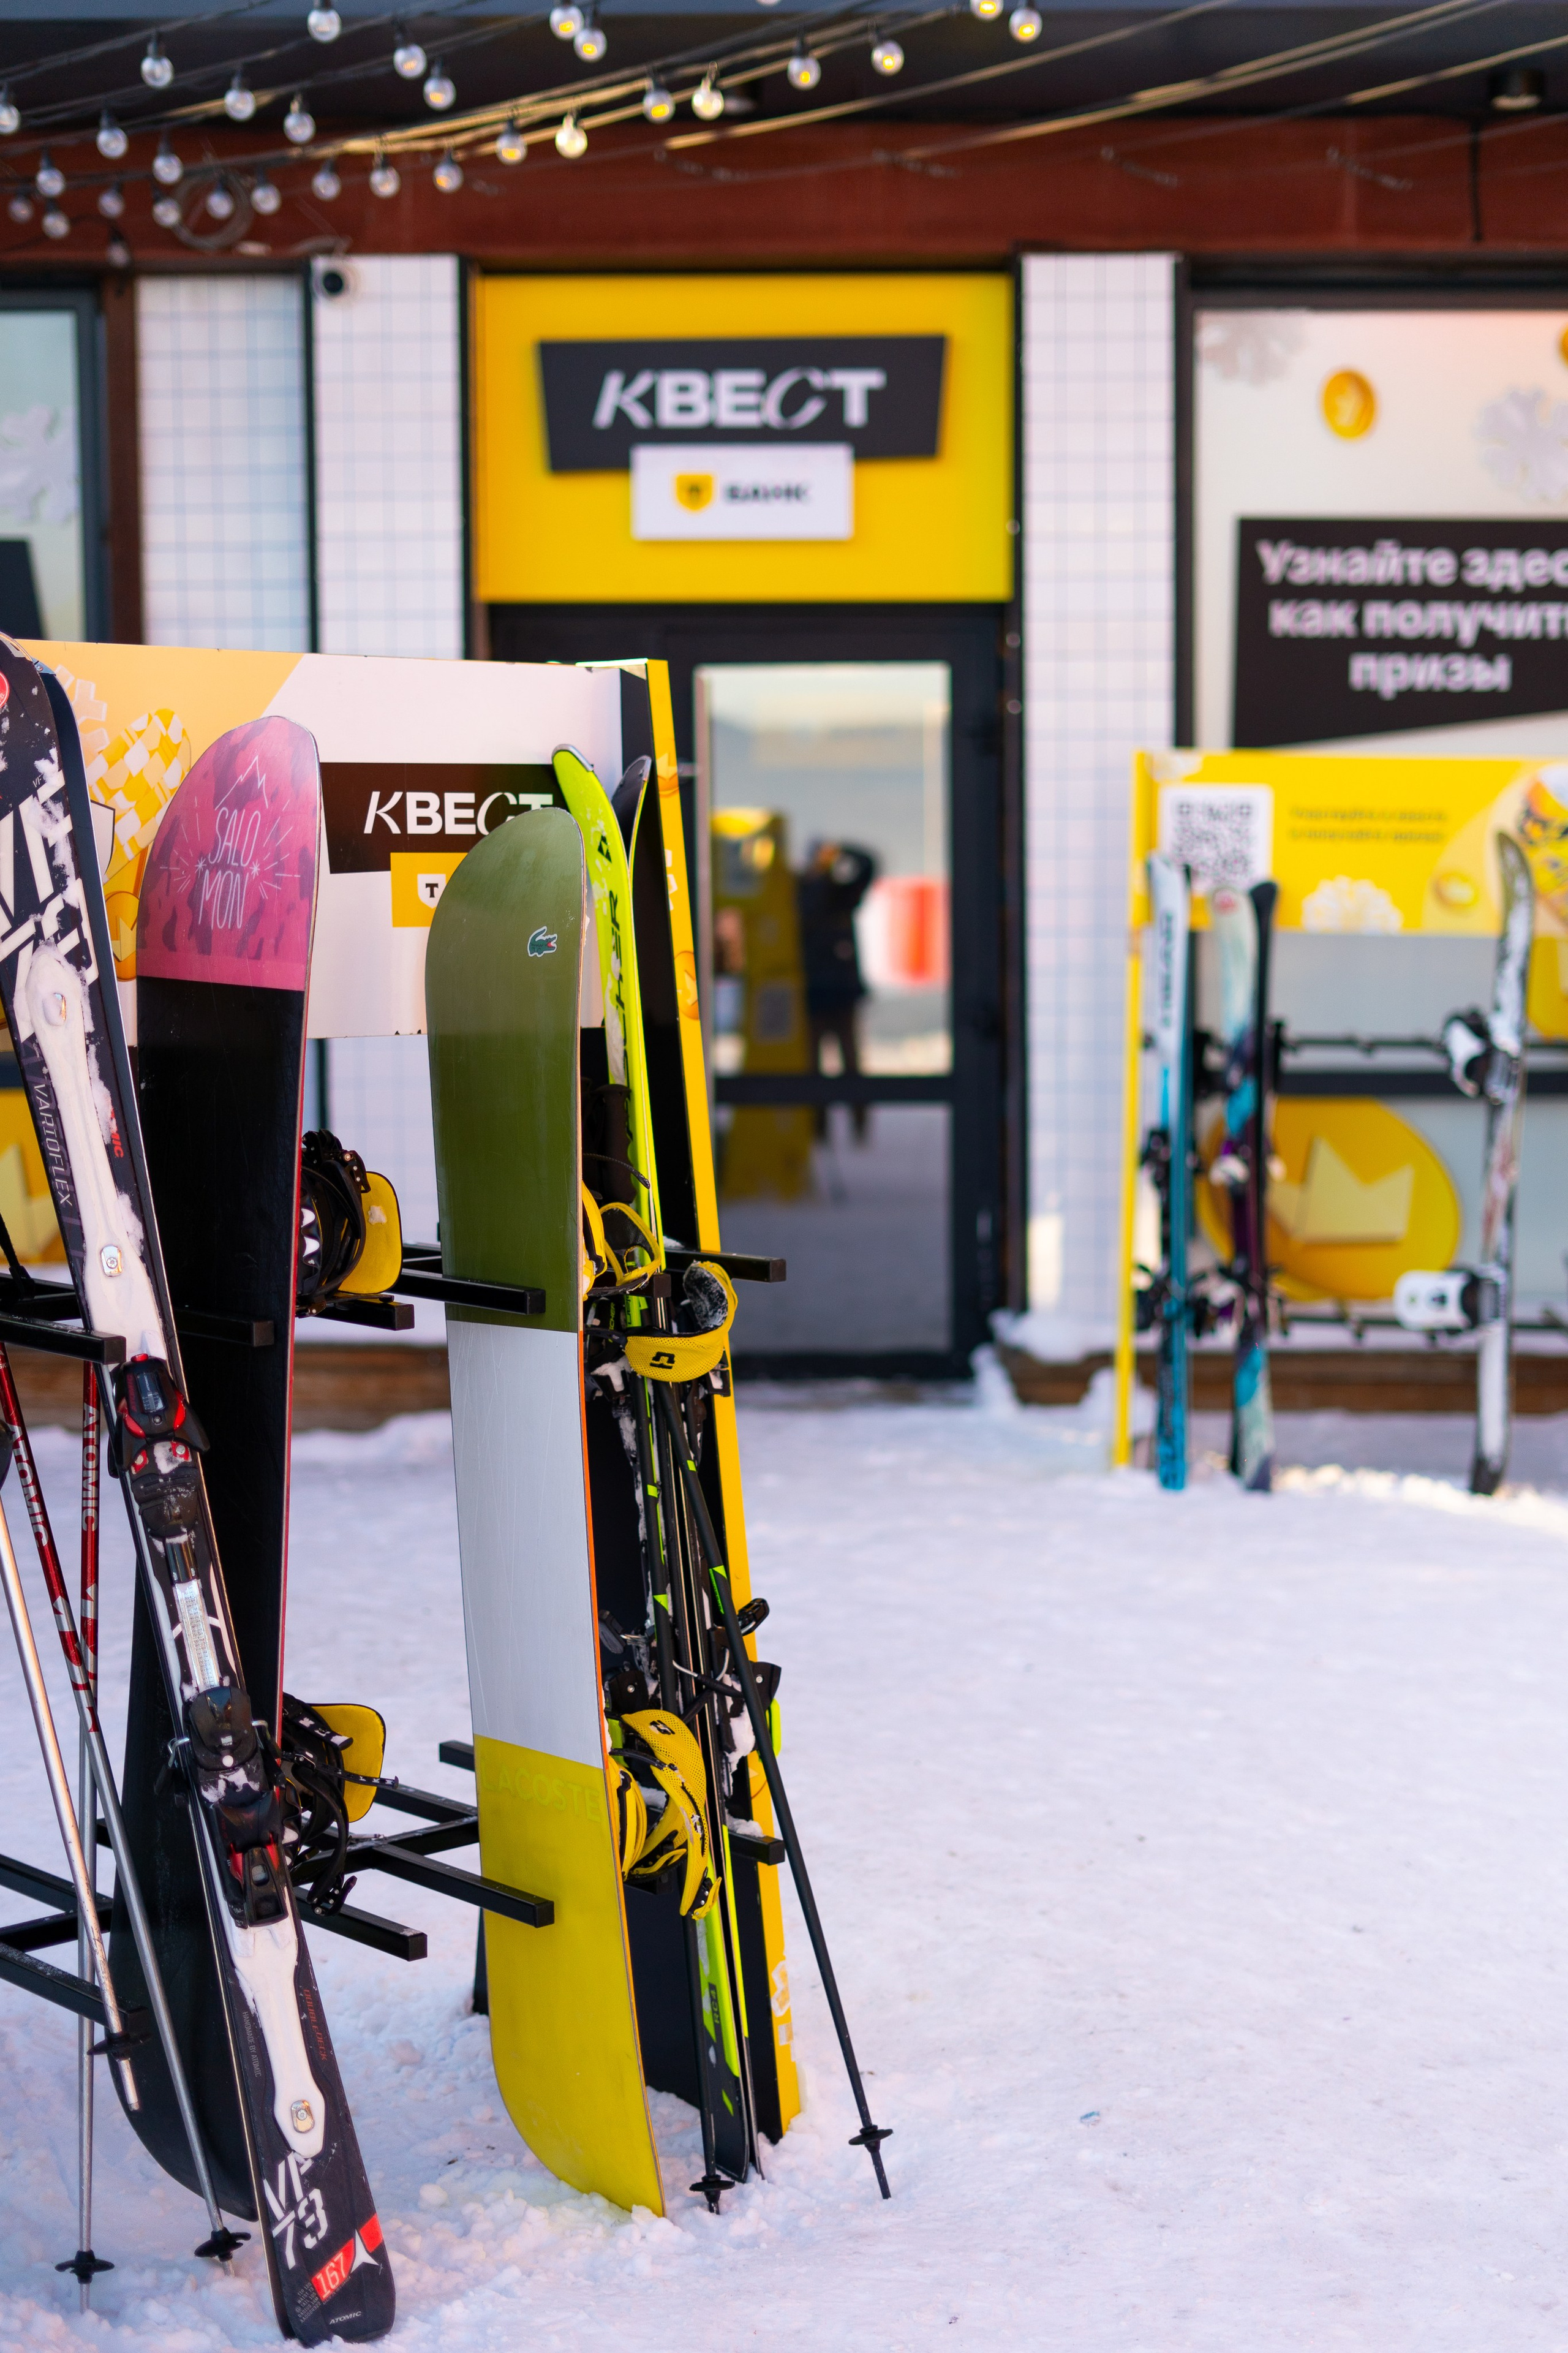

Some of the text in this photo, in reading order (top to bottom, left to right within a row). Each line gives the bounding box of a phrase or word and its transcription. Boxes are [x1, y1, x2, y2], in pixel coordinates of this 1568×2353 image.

[592, 368, 886, 429] КВЕСТ
[1256, 540, 1458, 586] Узнайте
[1269, 598, 1568, 648] как получит
[1349, 652, 1512, 700] призы
[208, 807, 261, 867] SALO
[364, 791, 554, 836] КВЕСТ
[198, 869, 249, 931] MON
[34, 1084, 73, 1206] VARIOFLEX
[7, 1422, 48, 1547] ATOMIC
[81, 1402, 99, 1532] ATOMIC
[480, 1757, 602, 1824] LACOSTE
[243, 2011, 262, 2077] HANDMADE BY ATOMIC
[315, 2031, 328, 2061] DECK
[297, 2292, 309, 2305] WAIST
[315, 2252, 346, 2299] 167
[298, 2303, 312, 2318] RADIUS
[329, 2311, 363, 2325] ATOMIC
